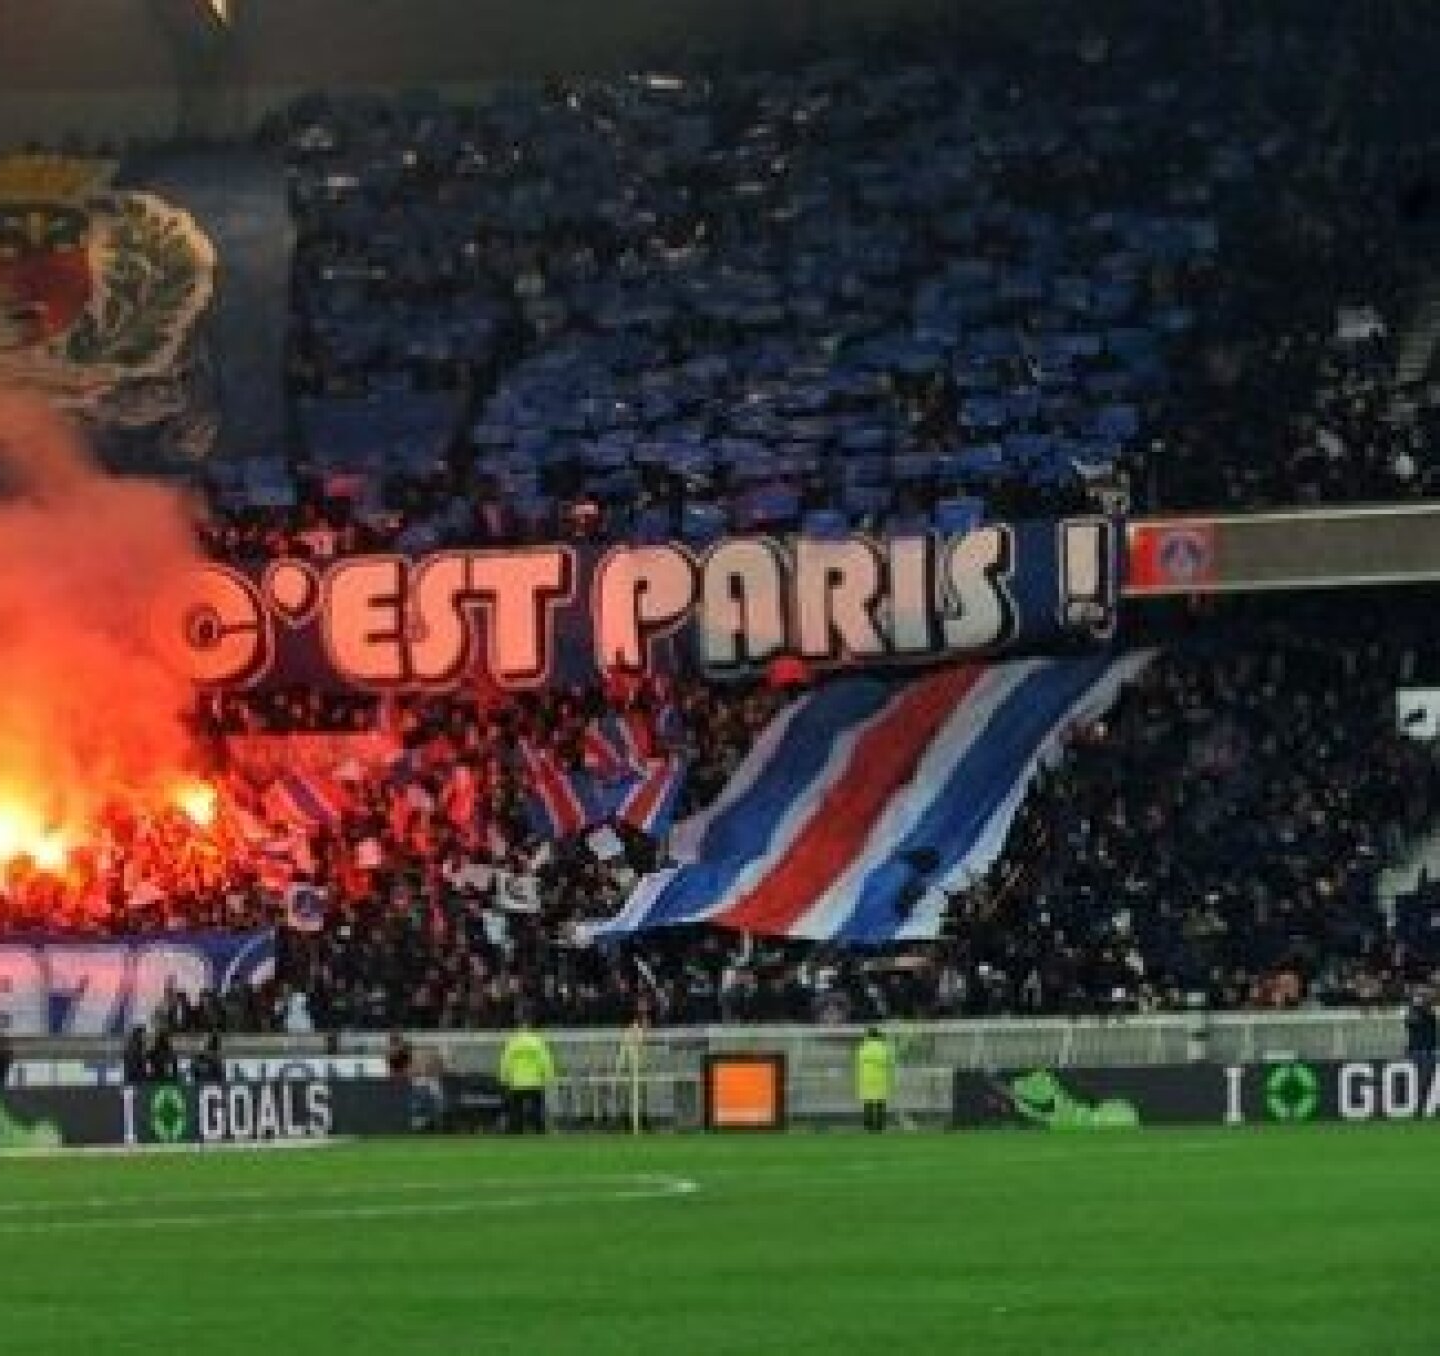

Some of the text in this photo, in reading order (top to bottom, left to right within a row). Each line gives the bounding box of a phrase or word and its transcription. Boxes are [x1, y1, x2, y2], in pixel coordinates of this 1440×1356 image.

[166, 551, 570, 686] C'EST
[596, 524, 1014, 674] PARIS
[198, 1082, 333, 1140] GOALS
